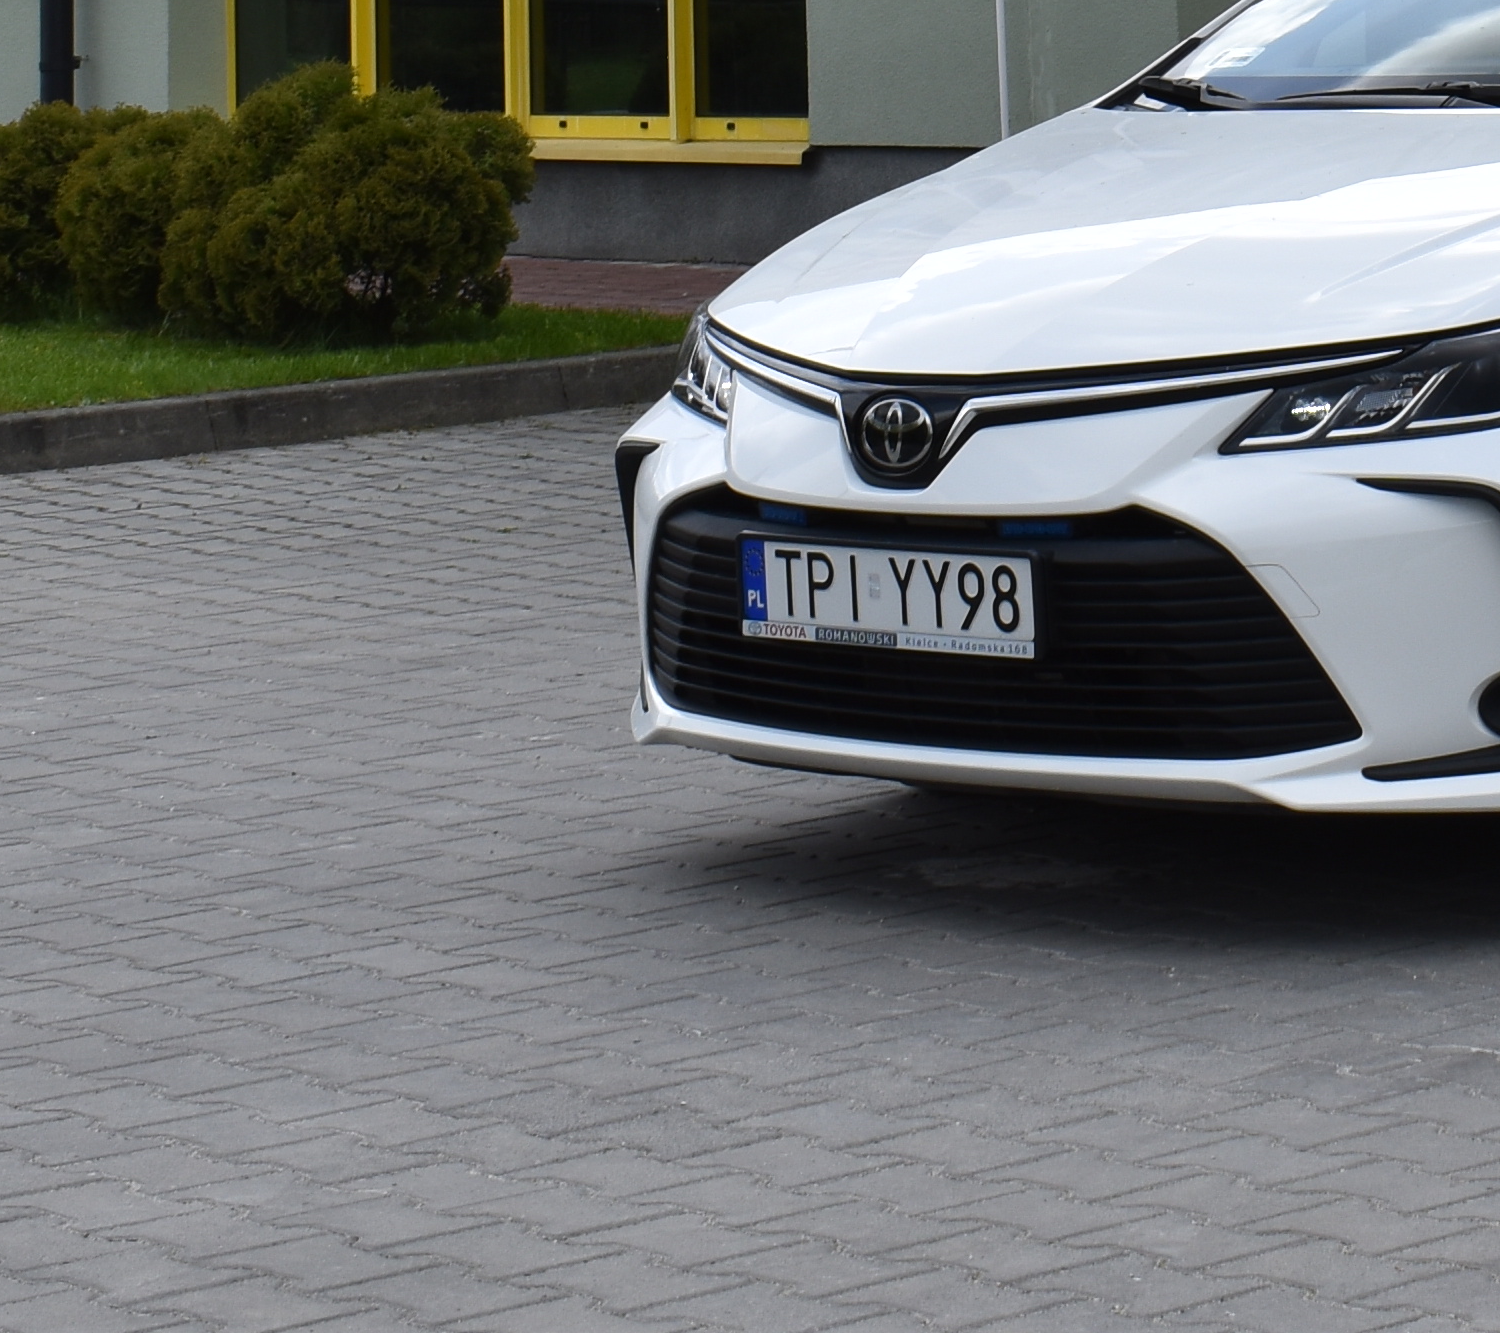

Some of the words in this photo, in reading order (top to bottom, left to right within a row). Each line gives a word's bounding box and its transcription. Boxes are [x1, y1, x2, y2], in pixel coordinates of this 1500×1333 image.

[747, 589, 765, 608] PL
[774, 548, 859, 623] TPI
[888, 556, 1021, 633] YY98
[763, 623, 807, 639] TOYOTA
[818, 628, 895, 645] ROMANOWSKI
[905, 636, 939, 648] Kielce
